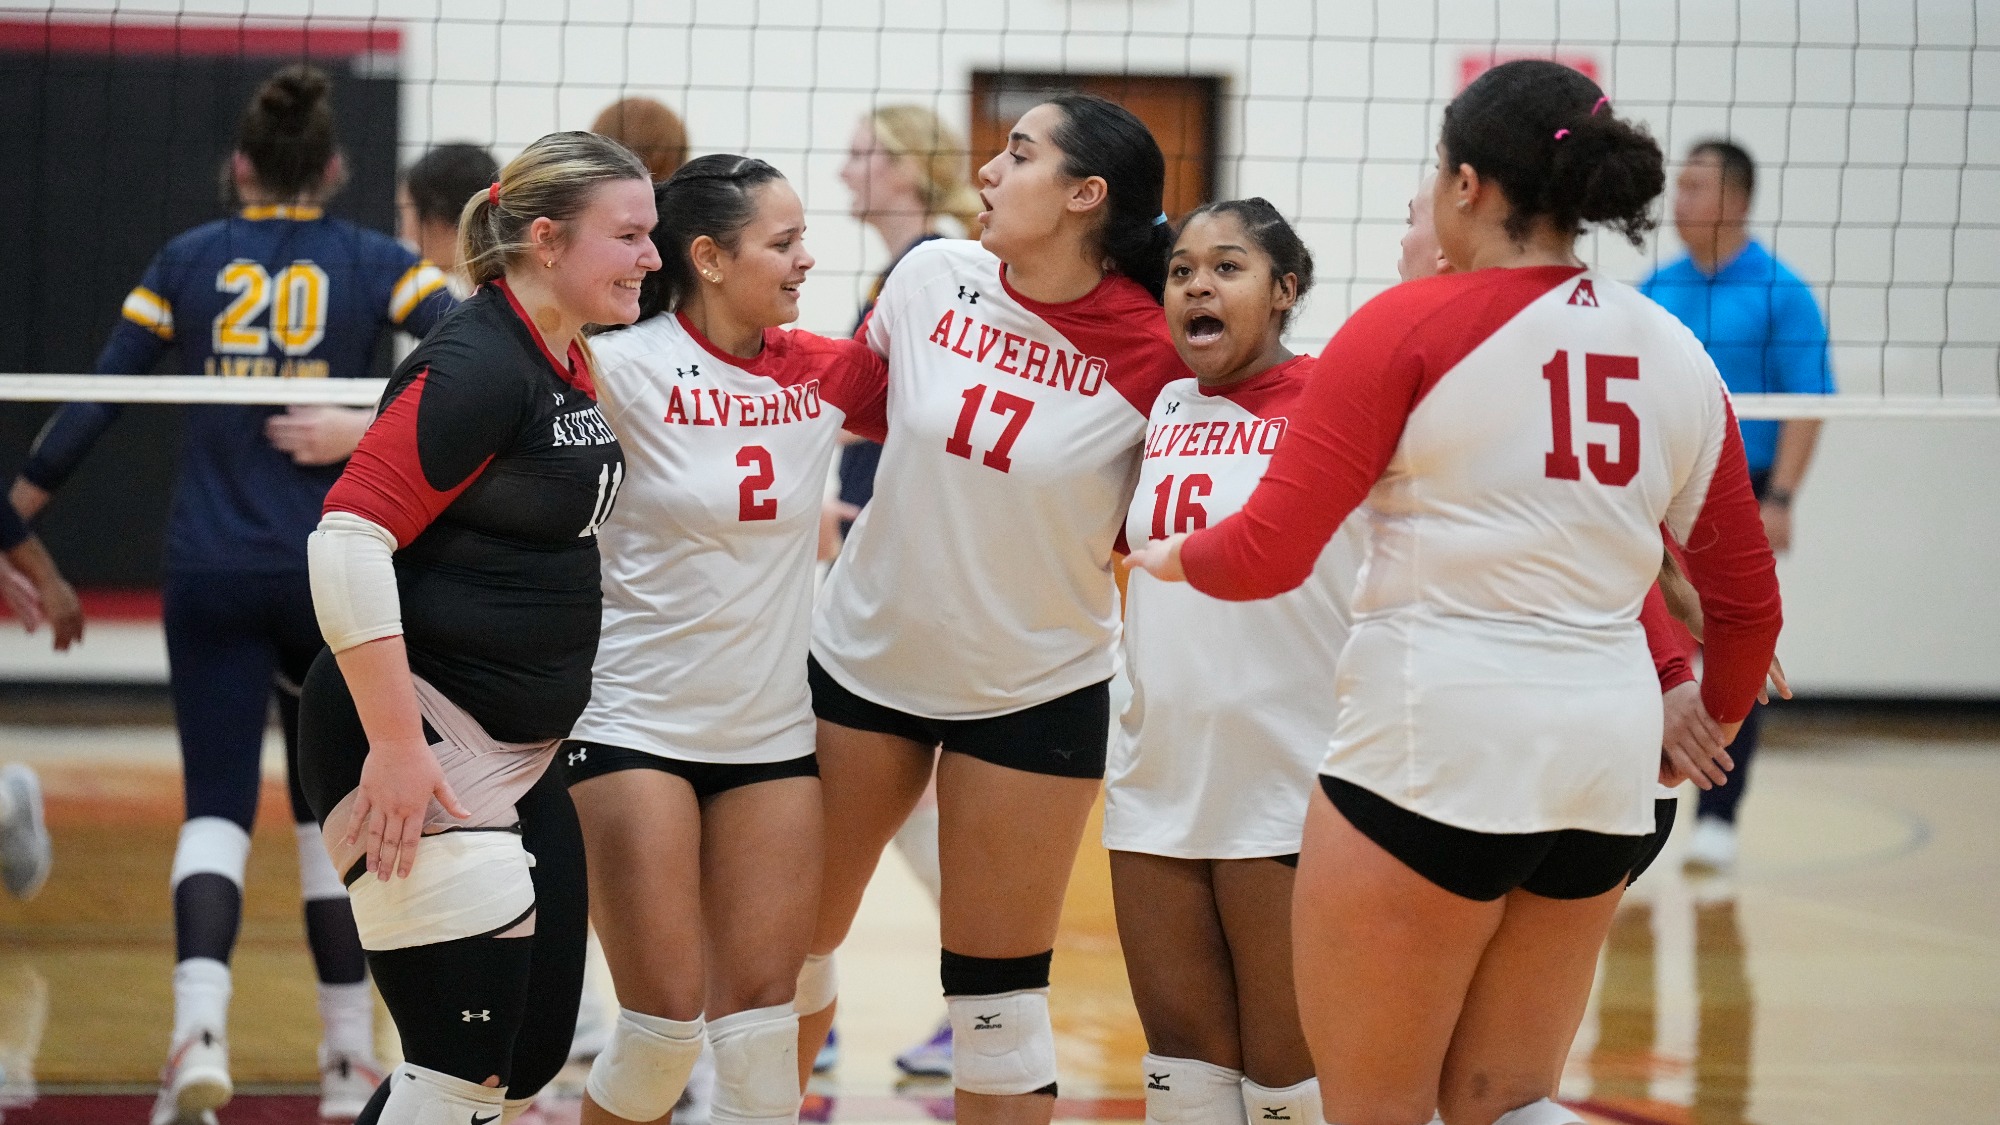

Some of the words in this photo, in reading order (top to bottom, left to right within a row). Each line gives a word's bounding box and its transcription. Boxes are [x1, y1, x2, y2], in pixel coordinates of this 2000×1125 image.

[211, 257, 330, 357] 20
[928, 308, 1109, 398] ALVERNO
[945, 382, 1036, 475] 17
[1541, 348, 1641, 488] 15
[578, 461, 623, 538] 11
[735, 445, 778, 522] 2
[1148, 473, 1214, 541] 16
